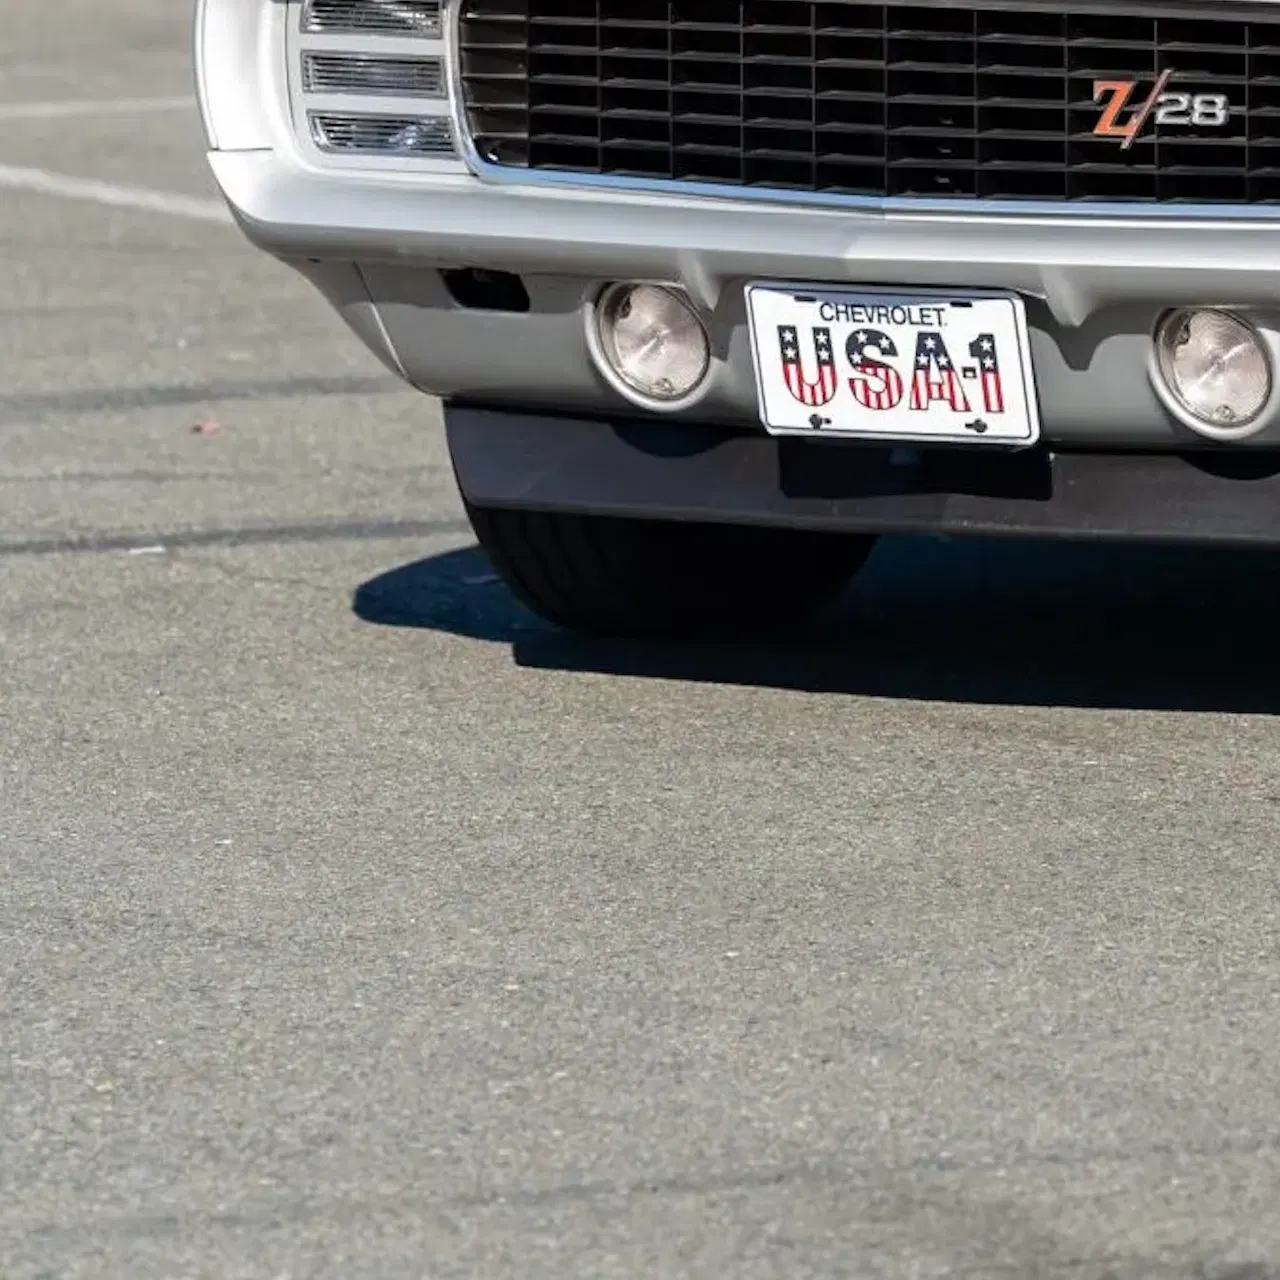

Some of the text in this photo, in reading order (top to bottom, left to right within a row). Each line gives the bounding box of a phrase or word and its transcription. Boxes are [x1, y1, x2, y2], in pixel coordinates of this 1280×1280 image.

[1093, 68, 1229, 150] Z/28
[820, 302, 945, 326] CHEVROLET
[777, 325, 1004, 413] USA-1
